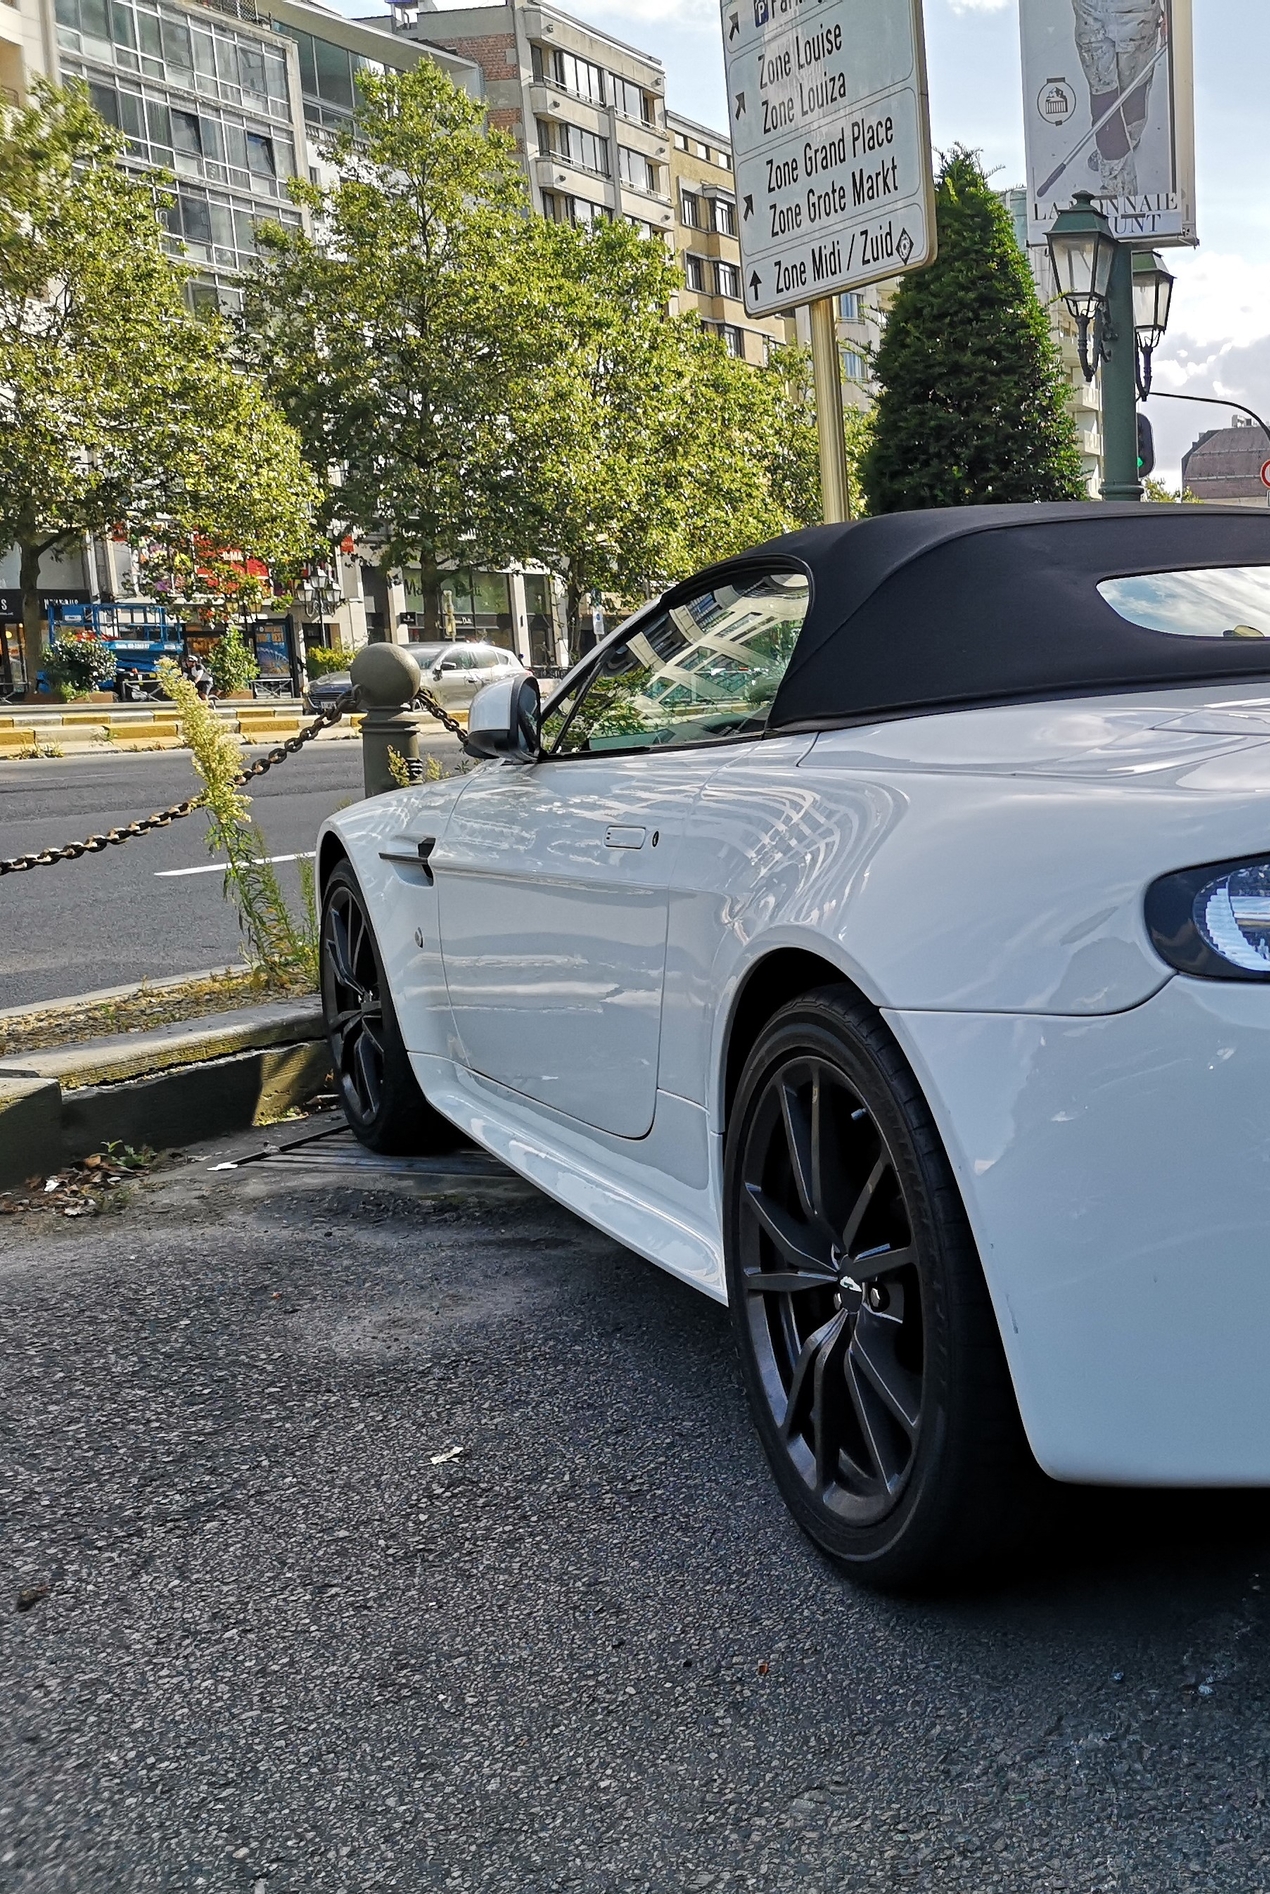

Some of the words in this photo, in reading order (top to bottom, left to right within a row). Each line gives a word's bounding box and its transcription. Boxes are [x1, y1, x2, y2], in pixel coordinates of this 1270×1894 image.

[757, 53, 792, 90] Zone
[795, 23, 843, 71] Louise
[761, 98, 795, 135] Zone
[800, 71, 847, 118] Louiza
[766, 158, 799, 194] Zone
[804, 130, 846, 178] Grand
[852, 116, 894, 159] Place
[769, 202, 802, 239] Zone
[807, 181, 847, 224] Grote
[851, 156, 899, 207] Markt
[1033, 201, 1059, 221] LA
[1069, 192, 1178, 214] NNAIE
[1110, 213, 1162, 235] UNT
[774, 259, 807, 294] Zone
[811, 240, 843, 282] Midi
[846, 234, 856, 271] /
[860, 220, 895, 266] Zuid
